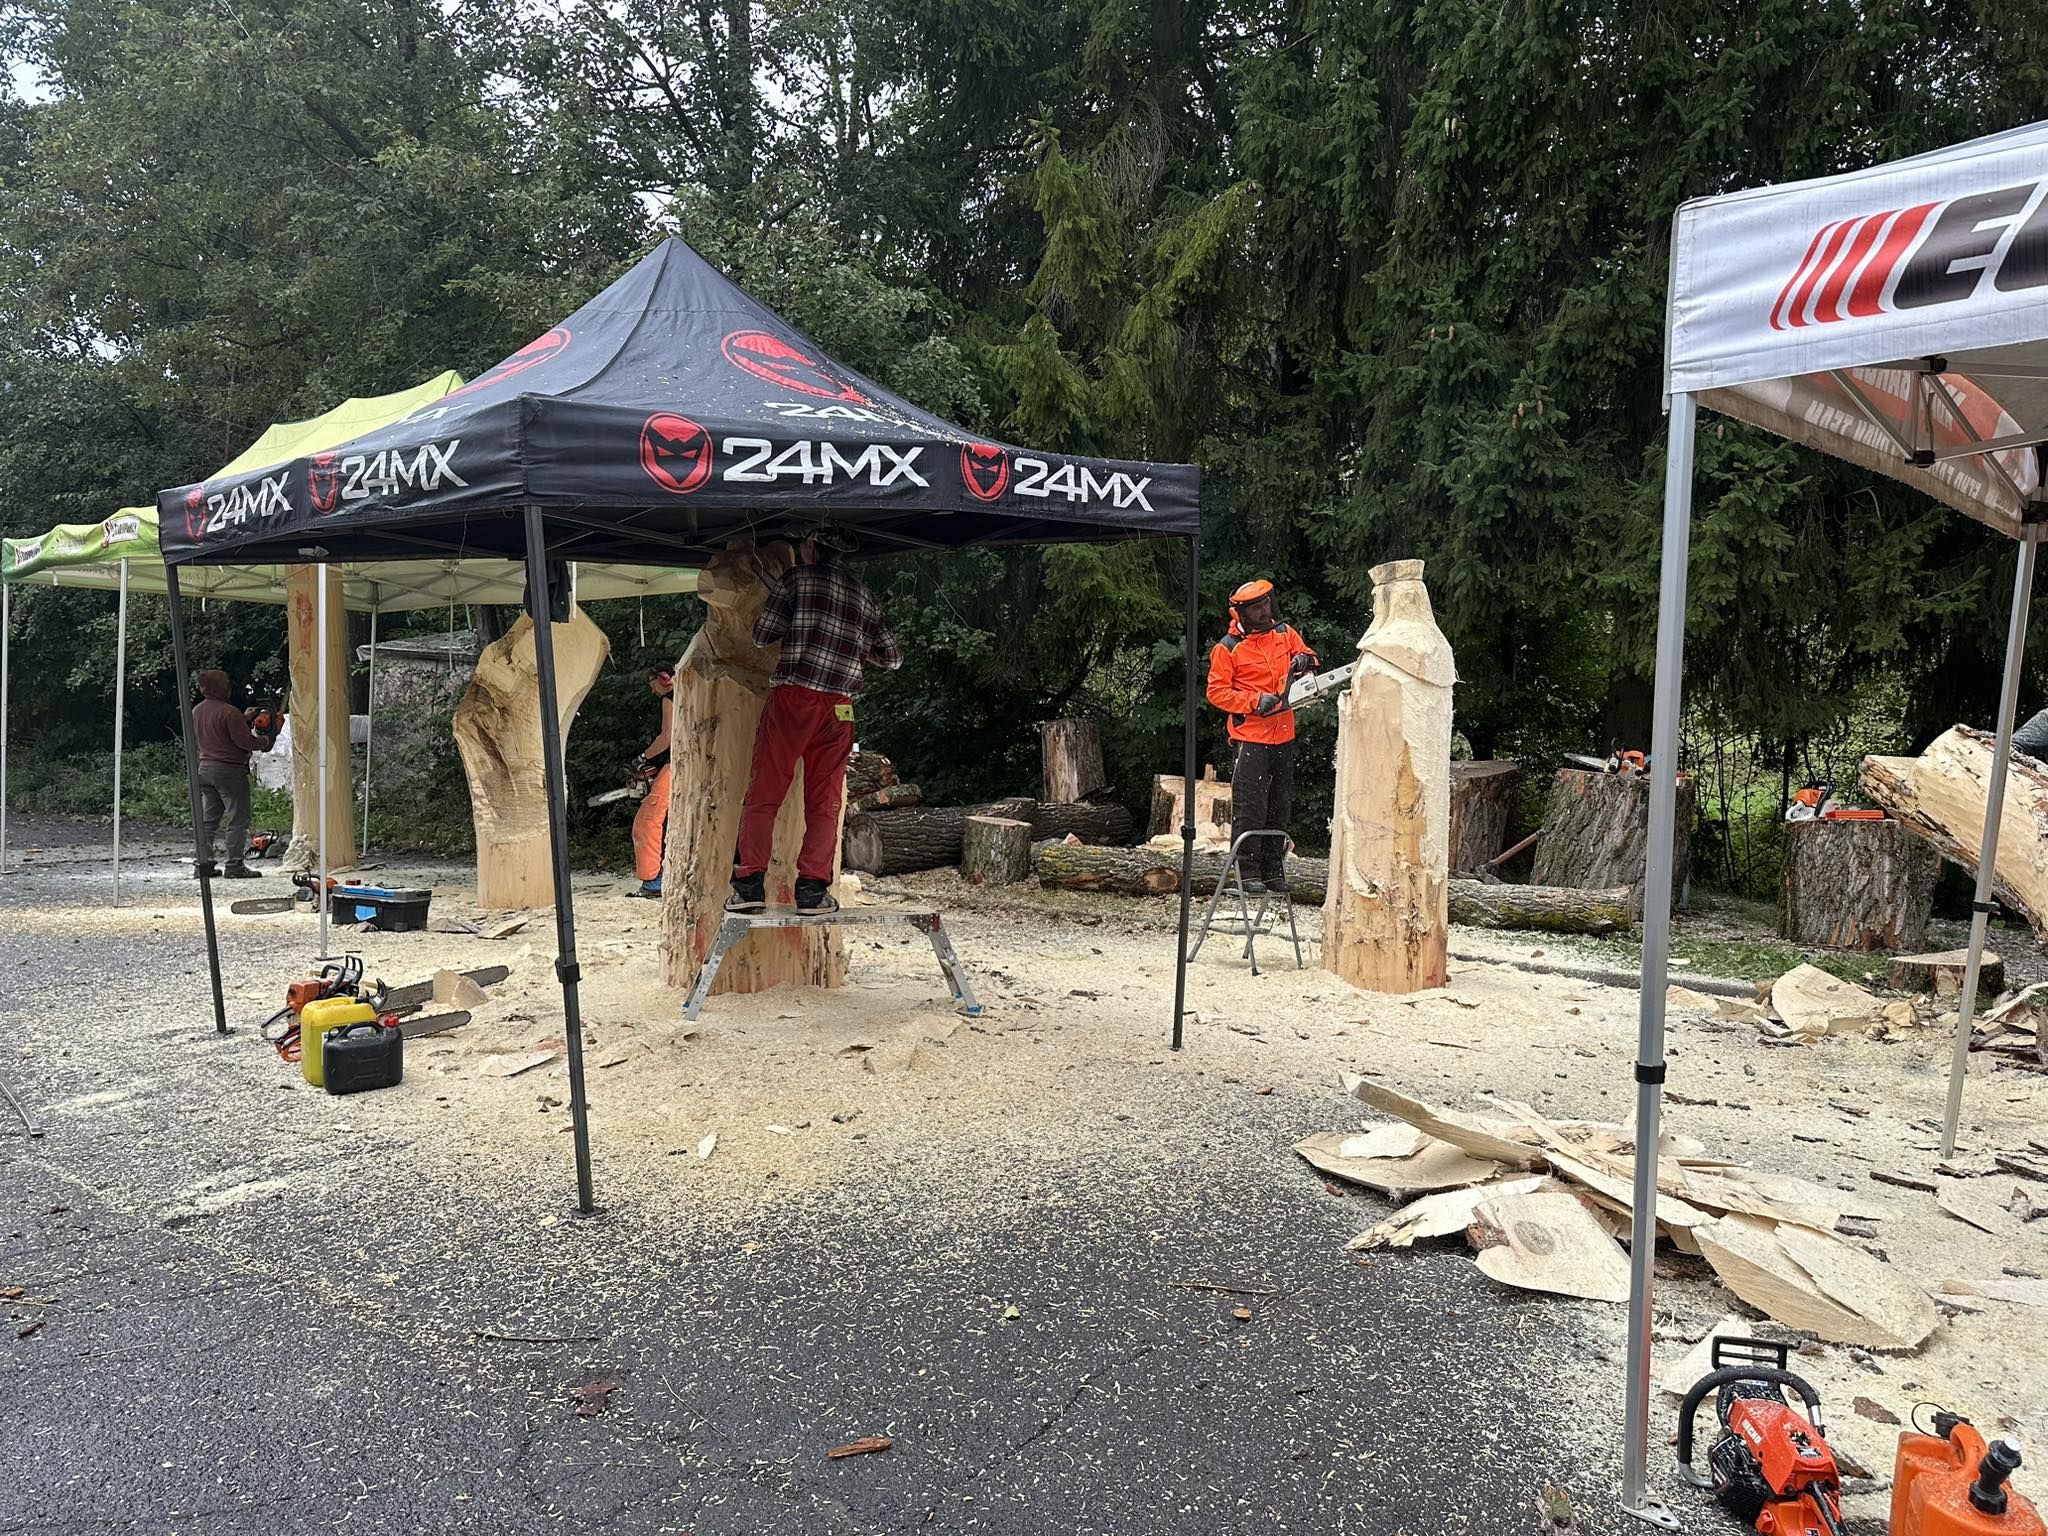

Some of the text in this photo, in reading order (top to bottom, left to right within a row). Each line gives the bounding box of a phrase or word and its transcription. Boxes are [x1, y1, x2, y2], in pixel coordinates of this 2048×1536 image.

[340, 439, 469, 499] 24MX
[722, 437, 930, 488] 24MX
[1014, 457, 1155, 512] 24MX
[206, 471, 293, 533] 24MX
